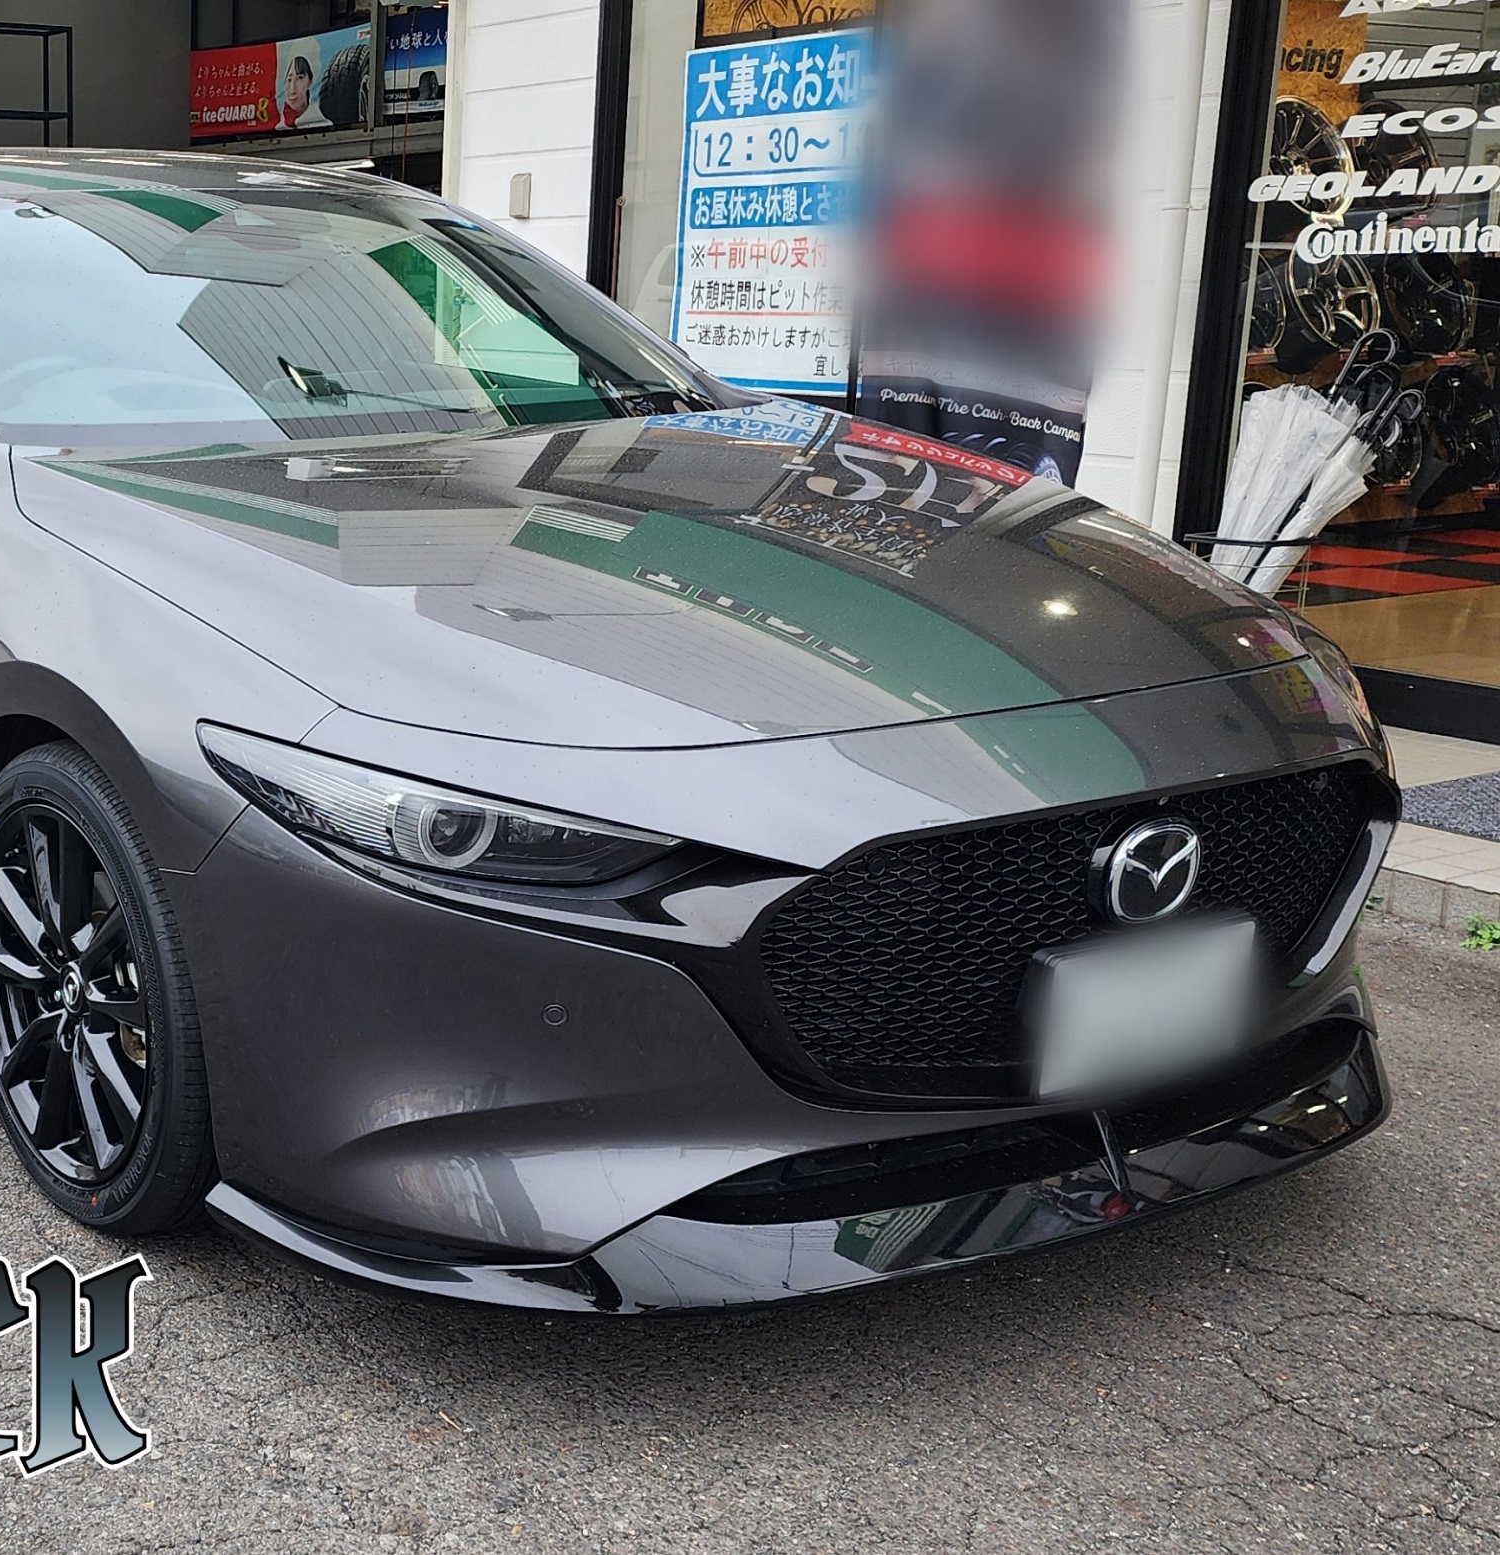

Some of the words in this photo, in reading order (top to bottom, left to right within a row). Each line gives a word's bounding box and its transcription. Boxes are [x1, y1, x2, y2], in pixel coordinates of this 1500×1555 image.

[386, 28, 448, 50] い地球と人
[1247, 165, 1500, 203] GEOLAND
[938, 397, 970, 415] Tire
